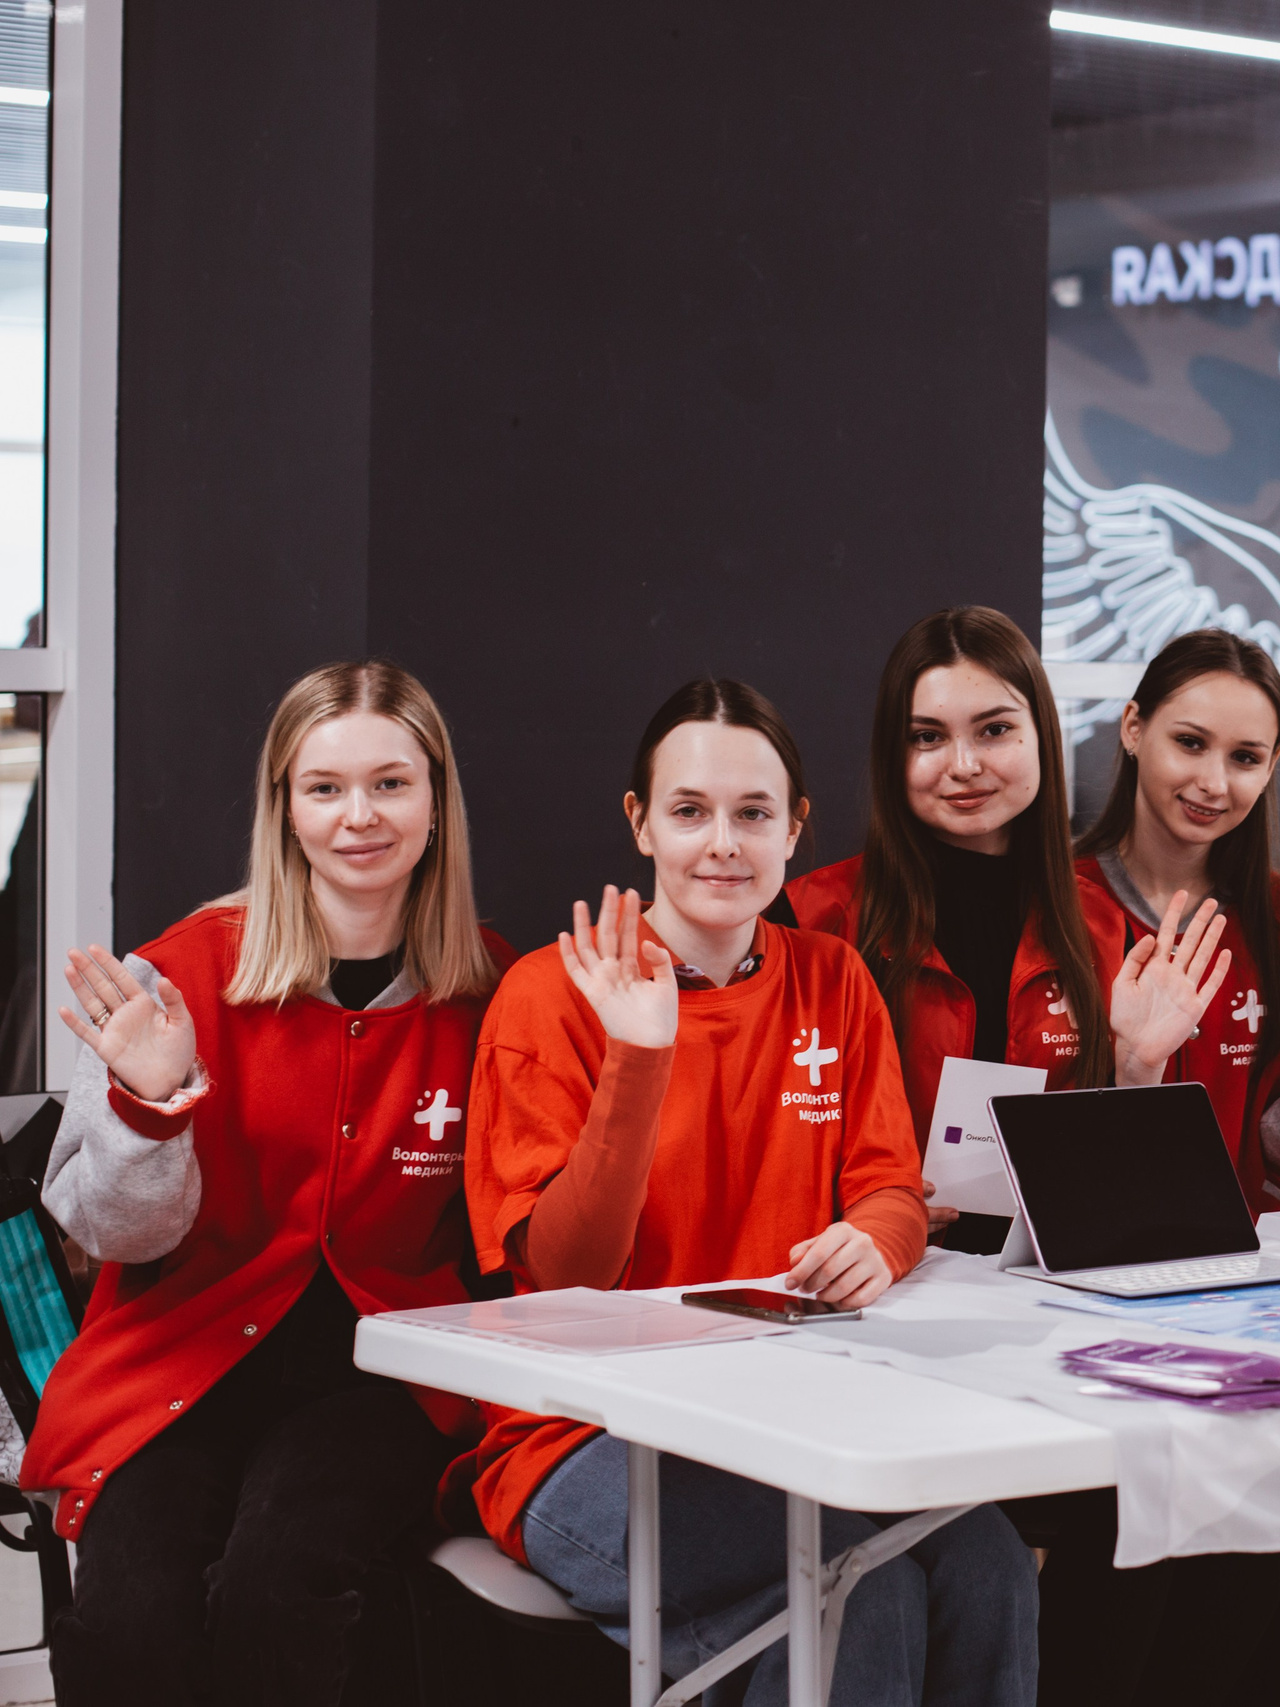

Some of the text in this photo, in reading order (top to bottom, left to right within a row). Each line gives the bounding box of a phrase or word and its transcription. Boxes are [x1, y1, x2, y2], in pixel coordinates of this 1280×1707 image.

[1041, 1031, 1080, 1044] Волон
[781, 1091, 841, 1107] Волонте
[798, 1108, 842, 1125] медик
[401, 1165, 454, 1178] медики
